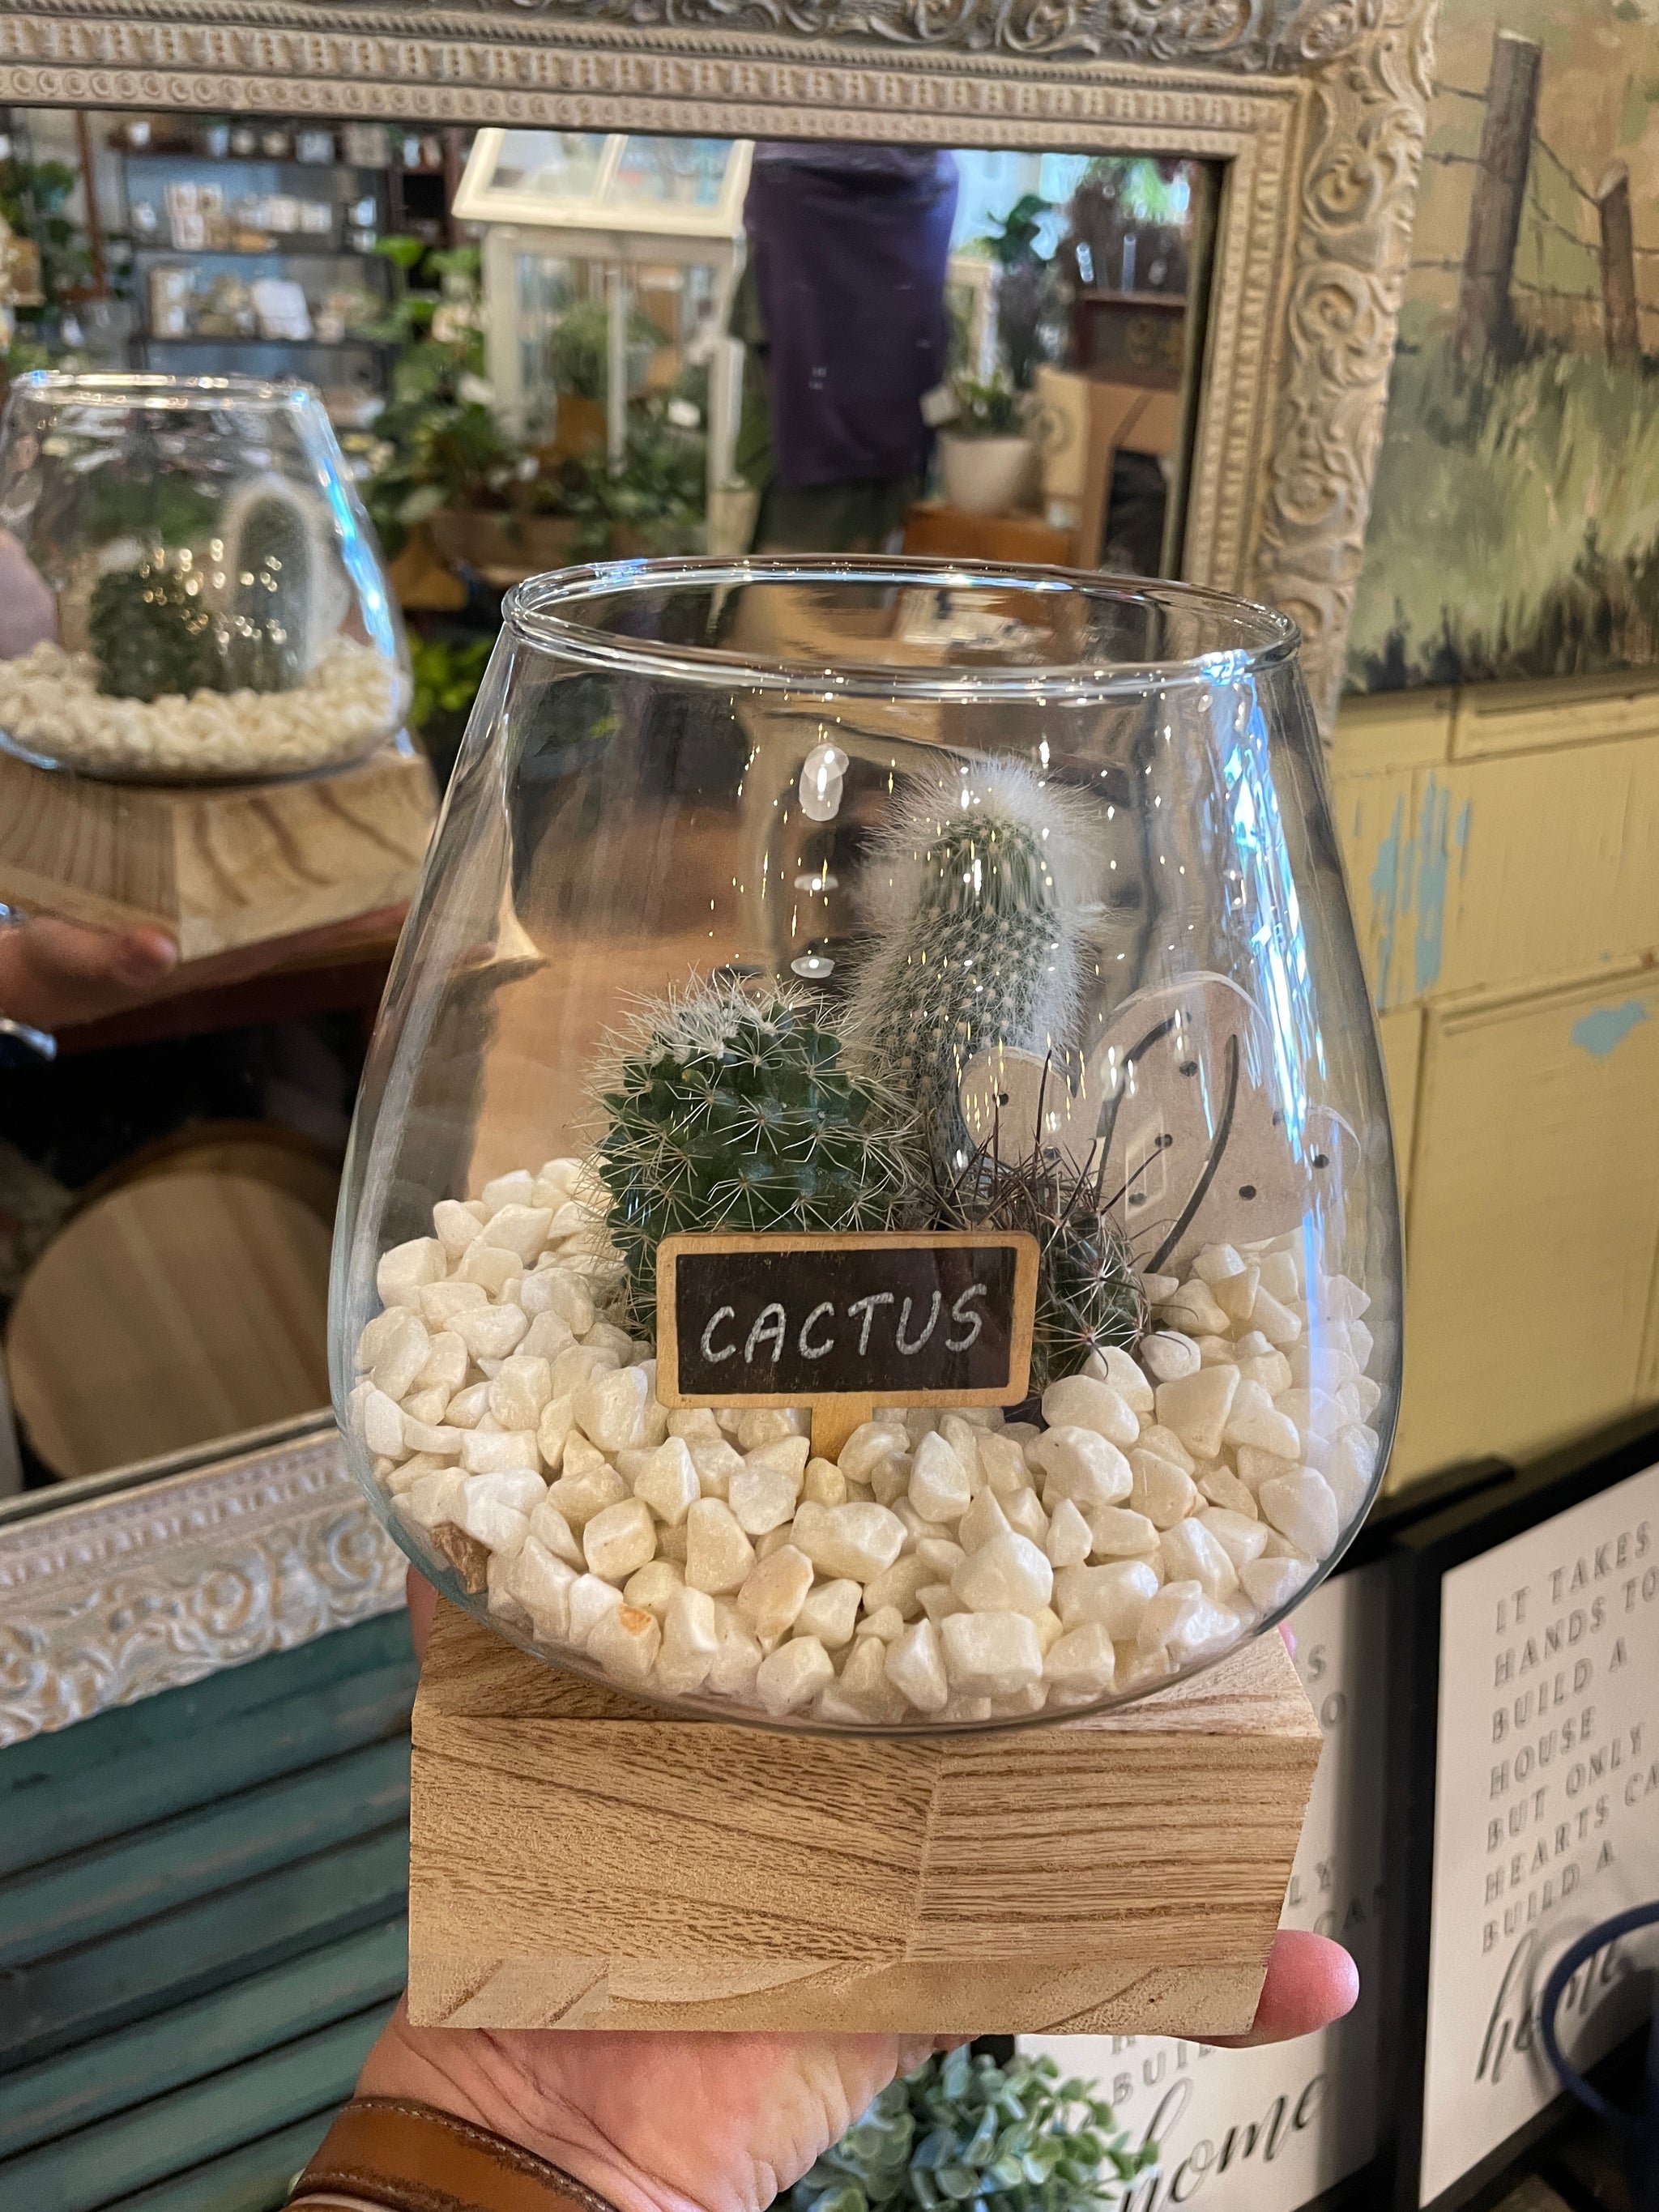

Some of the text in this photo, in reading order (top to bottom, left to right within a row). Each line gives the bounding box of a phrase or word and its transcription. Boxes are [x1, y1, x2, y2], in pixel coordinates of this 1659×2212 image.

[700, 1283, 987, 1364] CACTUS
[1495, 1520, 1652, 1635] IT TAKES
[1495, 1565, 1659, 1687] HANDS TO
[1491, 1636, 1627, 1744] BUILD A
[1486, 1721, 1645, 1853] BUT ONLY
[1490, 1705, 1596, 1801] HOUSE
[1482, 1839, 1615, 1954] BUILD A
[1484, 1793, 1610, 1906] HEARTS
